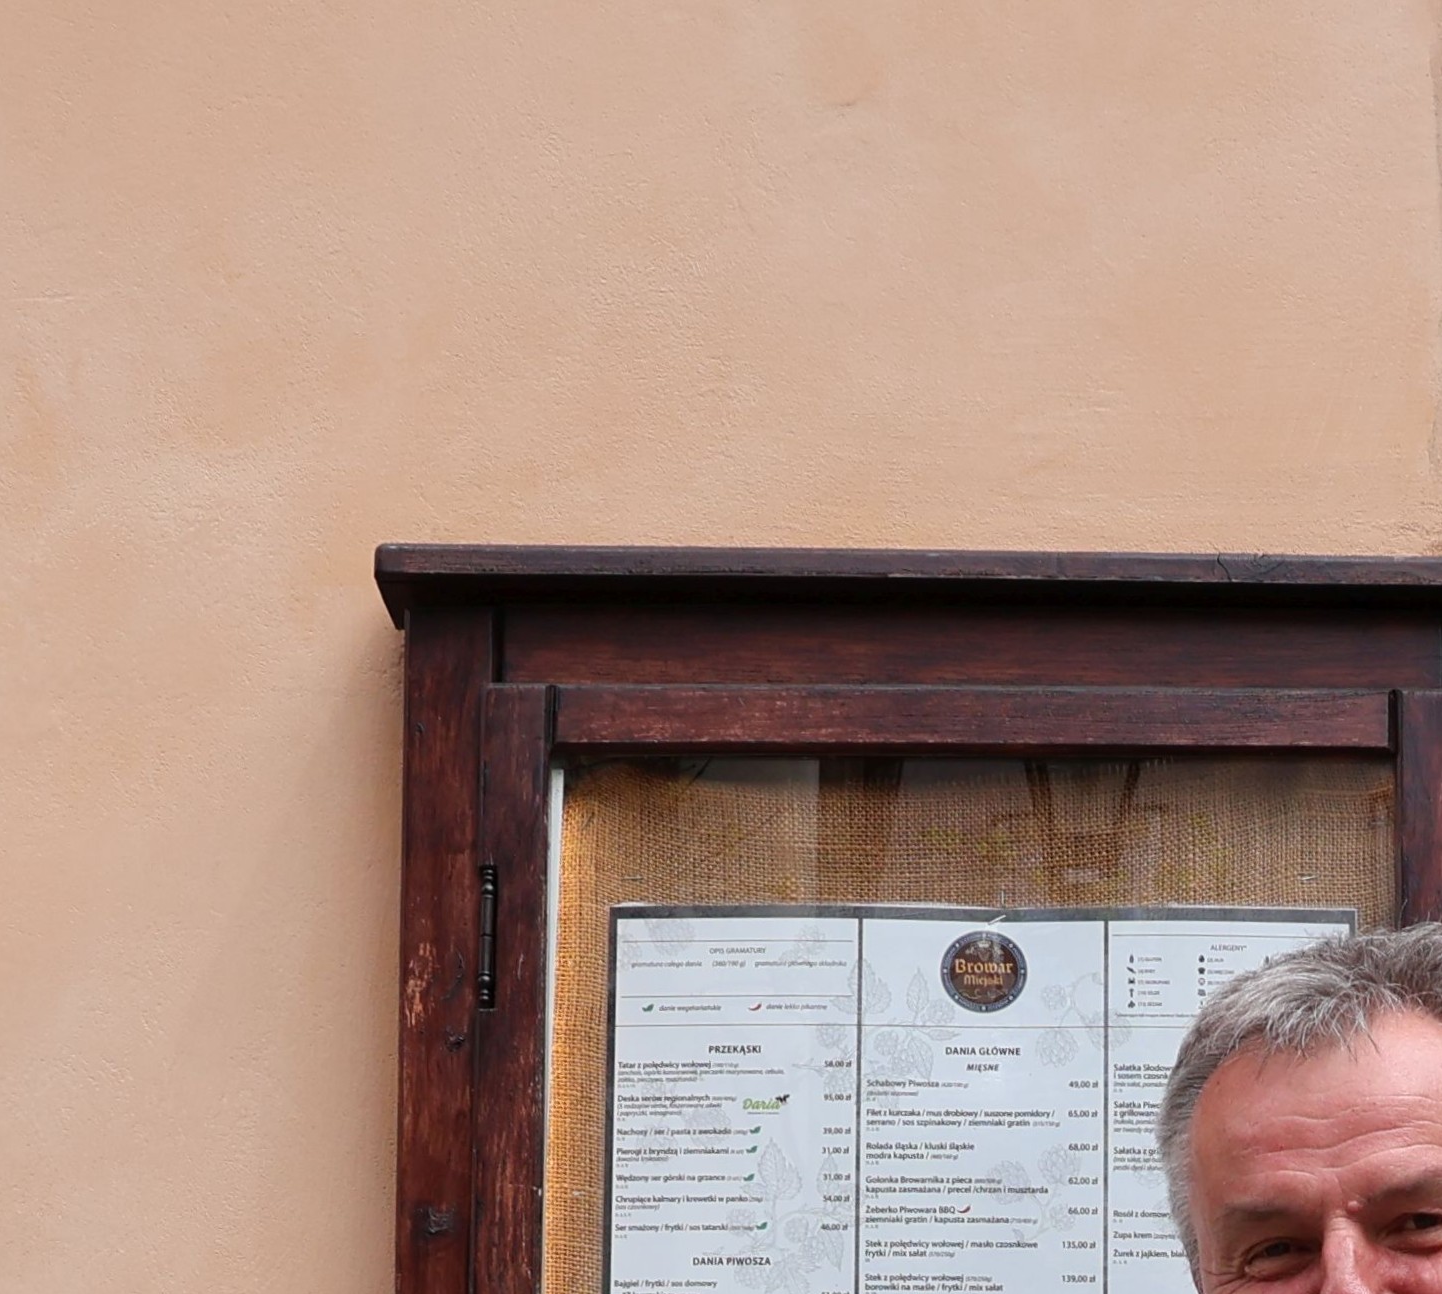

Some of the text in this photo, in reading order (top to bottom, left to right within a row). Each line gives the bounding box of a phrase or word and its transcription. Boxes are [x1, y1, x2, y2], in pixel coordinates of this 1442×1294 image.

[955, 958, 1014, 974] Browar
[743, 1098, 780, 1110] Daria
[726, 1257, 771, 1265] PIWOSZA
